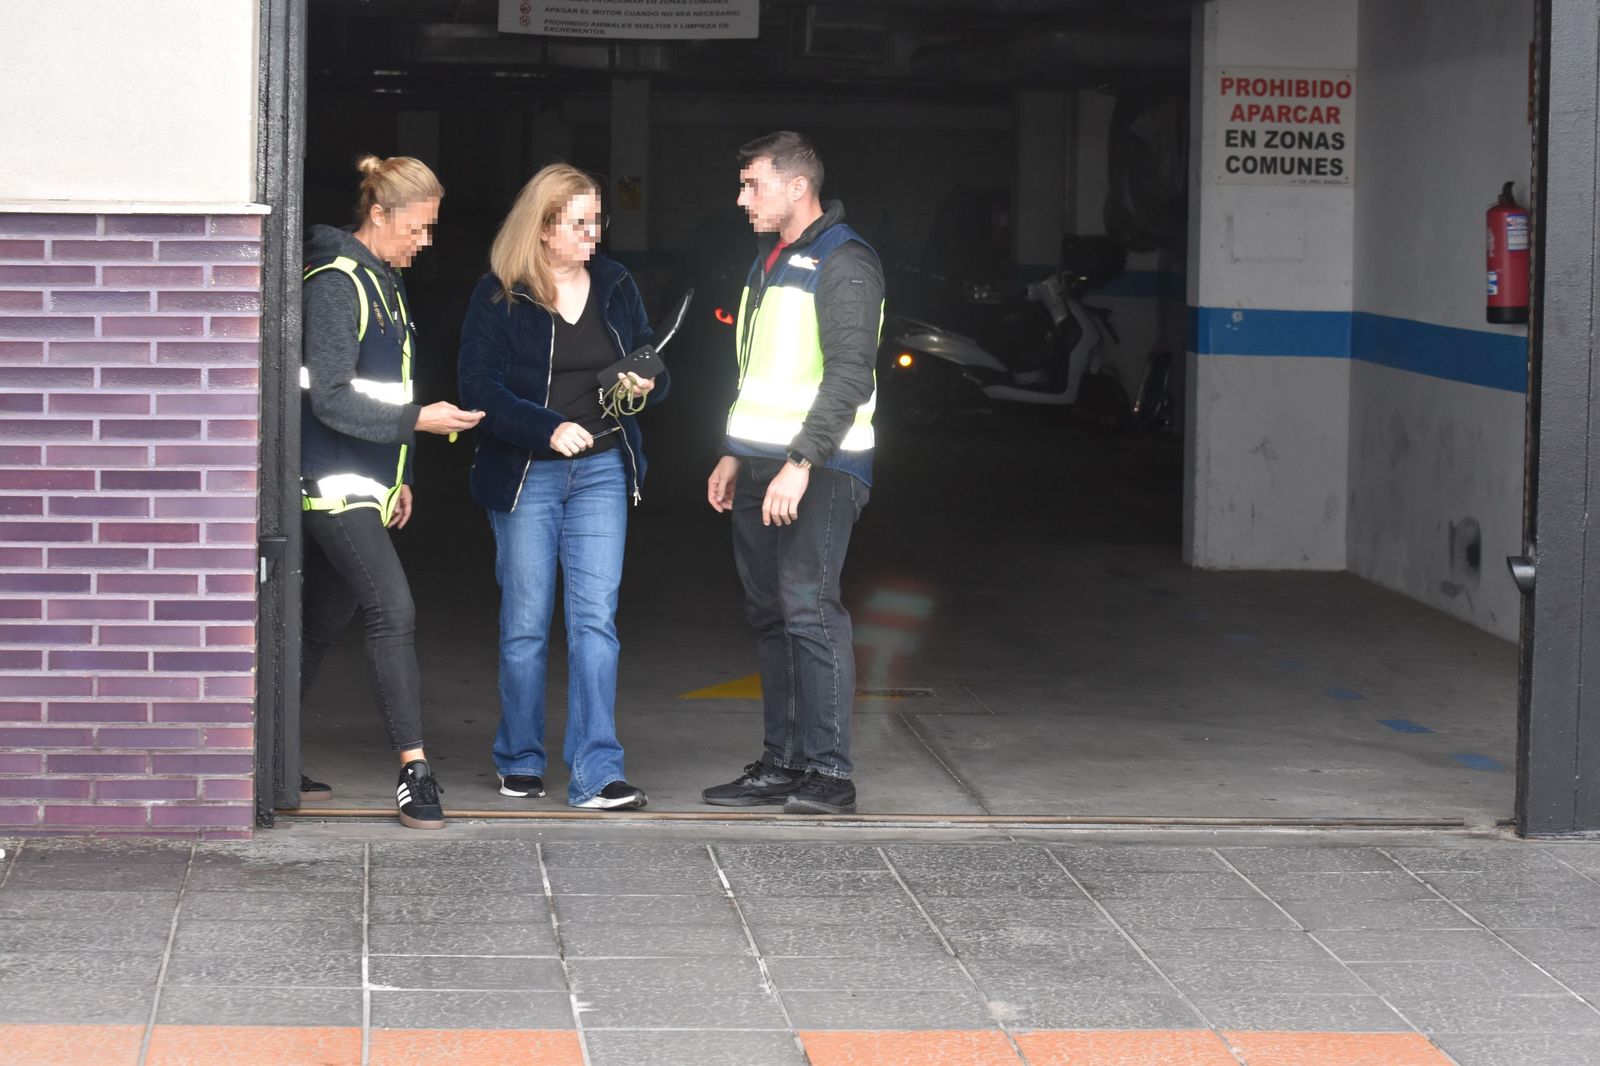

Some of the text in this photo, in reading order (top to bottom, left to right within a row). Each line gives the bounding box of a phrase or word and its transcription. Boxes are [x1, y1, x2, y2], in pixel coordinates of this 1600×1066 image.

[544, 18, 589, 27] PROHIBIDO
[591, 21, 632, 29] ANIMALES
[1220, 77, 1352, 99] PROHIBIDO
[1230, 103, 1341, 125] APARCAR
[1225, 129, 1345, 151] EN ZONAS
[1225, 155, 1343, 176] COMUNES
